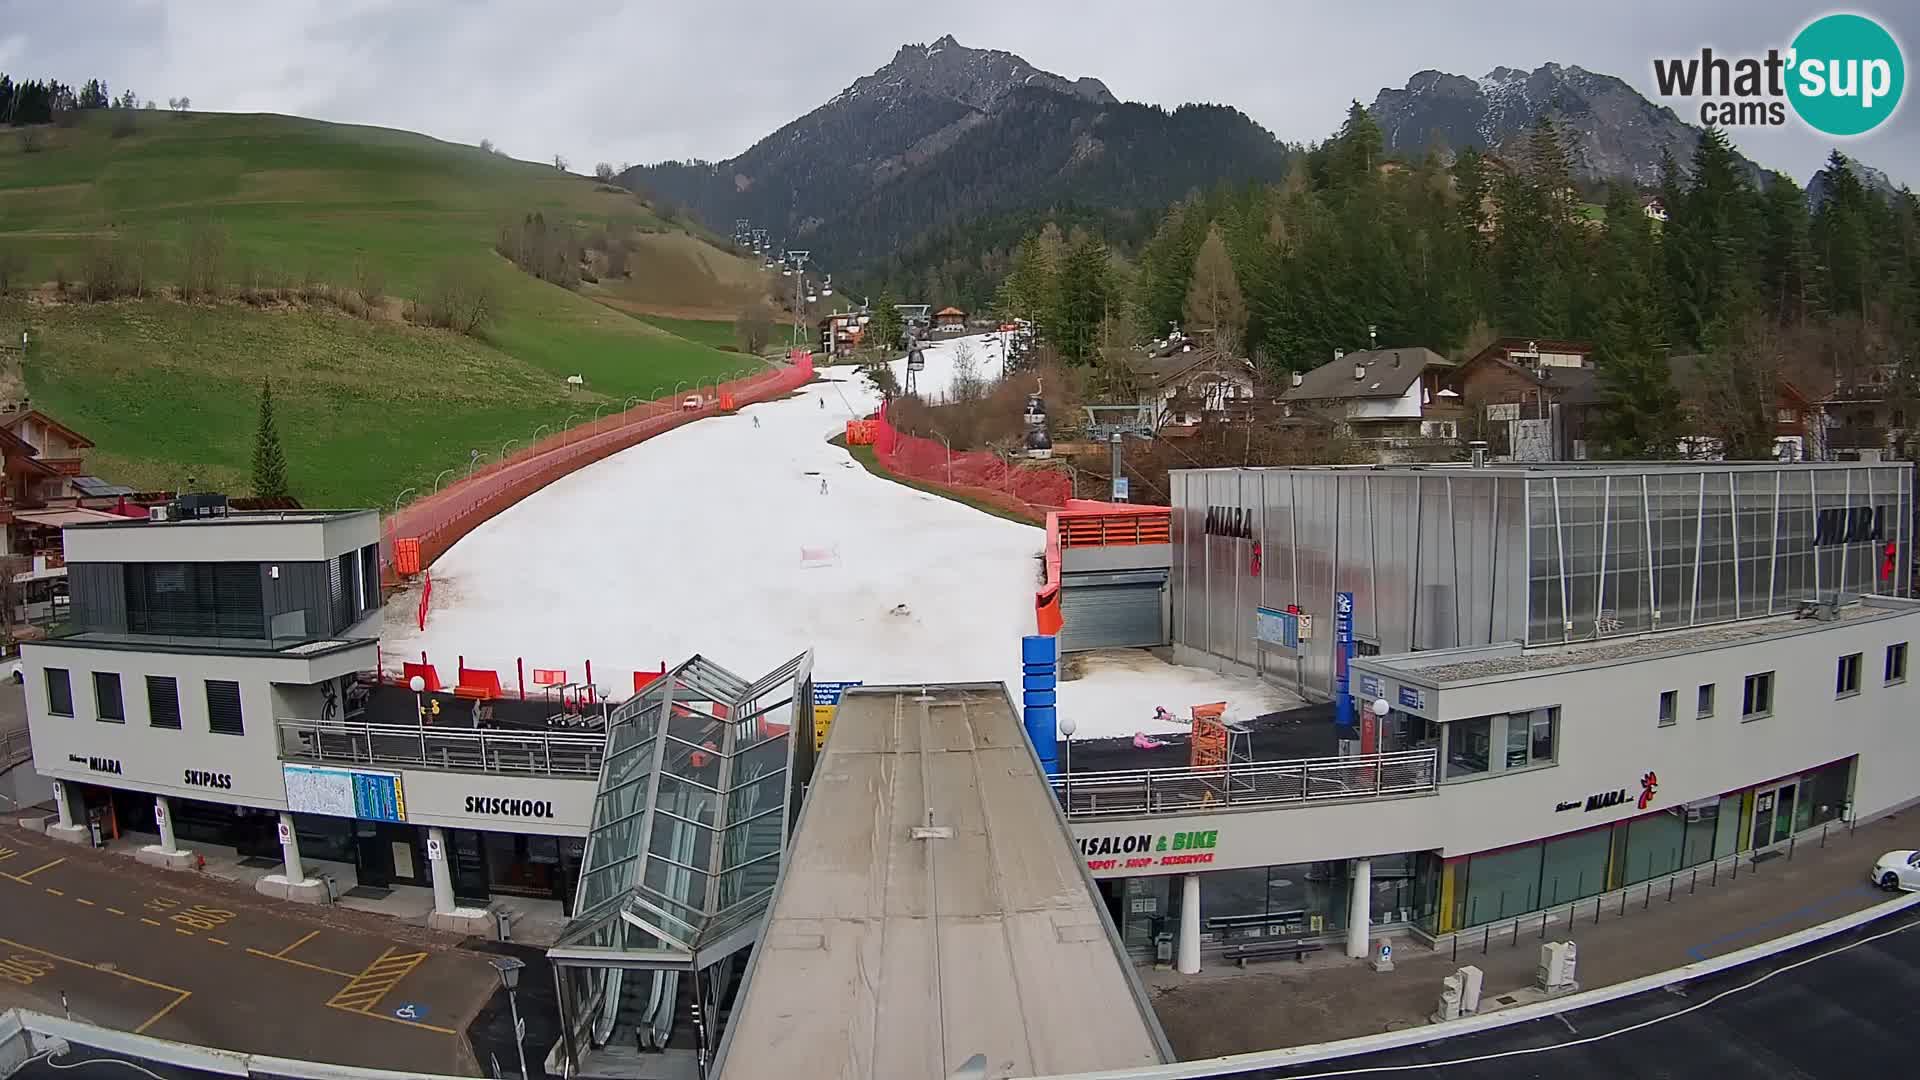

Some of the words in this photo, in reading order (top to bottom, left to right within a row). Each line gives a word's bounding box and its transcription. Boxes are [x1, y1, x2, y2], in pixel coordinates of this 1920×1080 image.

[1205, 506, 1252, 539] MIARA
[1814, 506, 1884, 546] MIARA
[90, 756, 122, 775] MIARA
[184, 769, 232, 790] SKIPASS
[465, 796, 554, 818] SKISCHOOL
[1584, 789, 1626, 812] MIARA
[1156, 836, 1167, 851] &
[1173, 831, 1217, 850] BIKE
[168, 905, 237, 929] BUS
